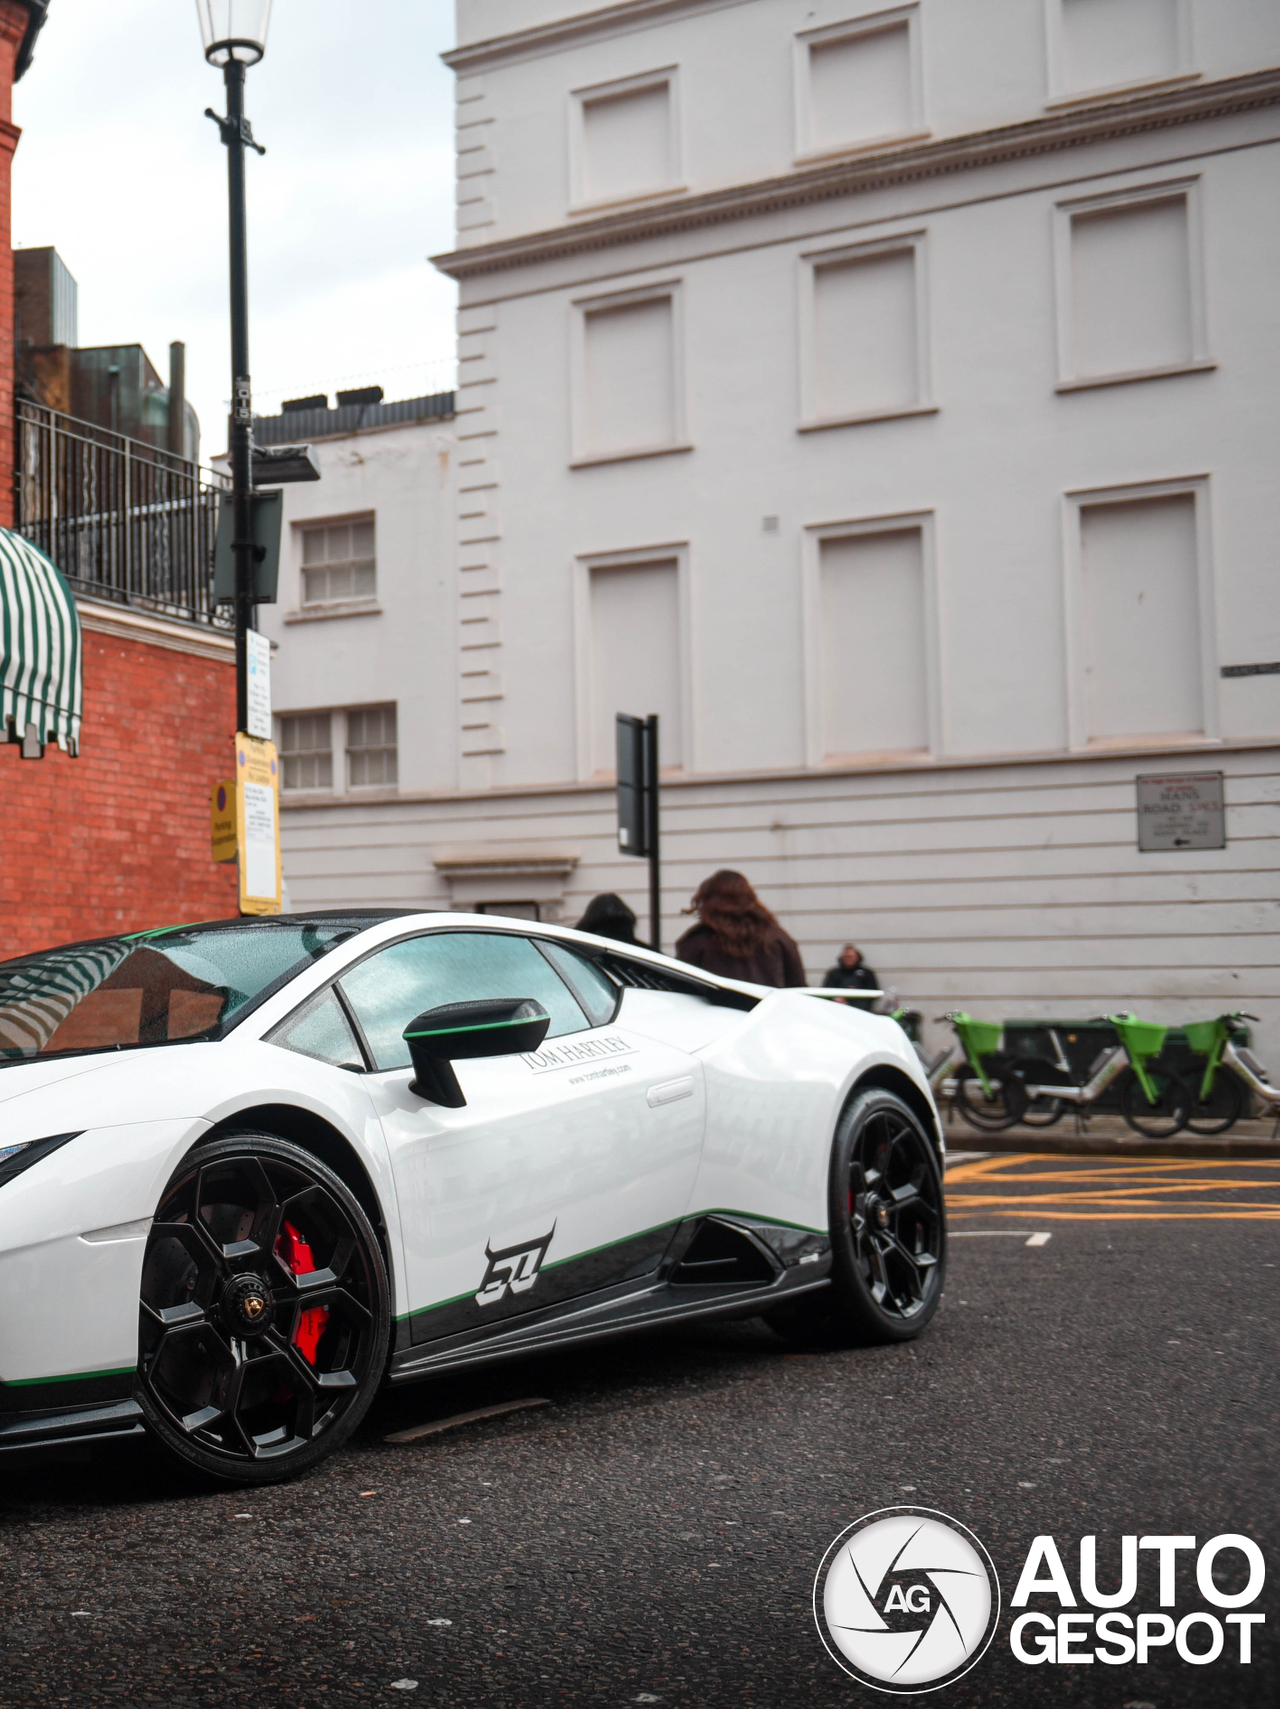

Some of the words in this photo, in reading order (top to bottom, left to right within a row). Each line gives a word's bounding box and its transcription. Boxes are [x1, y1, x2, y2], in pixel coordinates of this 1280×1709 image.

[1143, 802, 1181, 814] ROAD
[517, 1049, 565, 1070] TOM
[556, 1036, 632, 1062] HARTLEY
